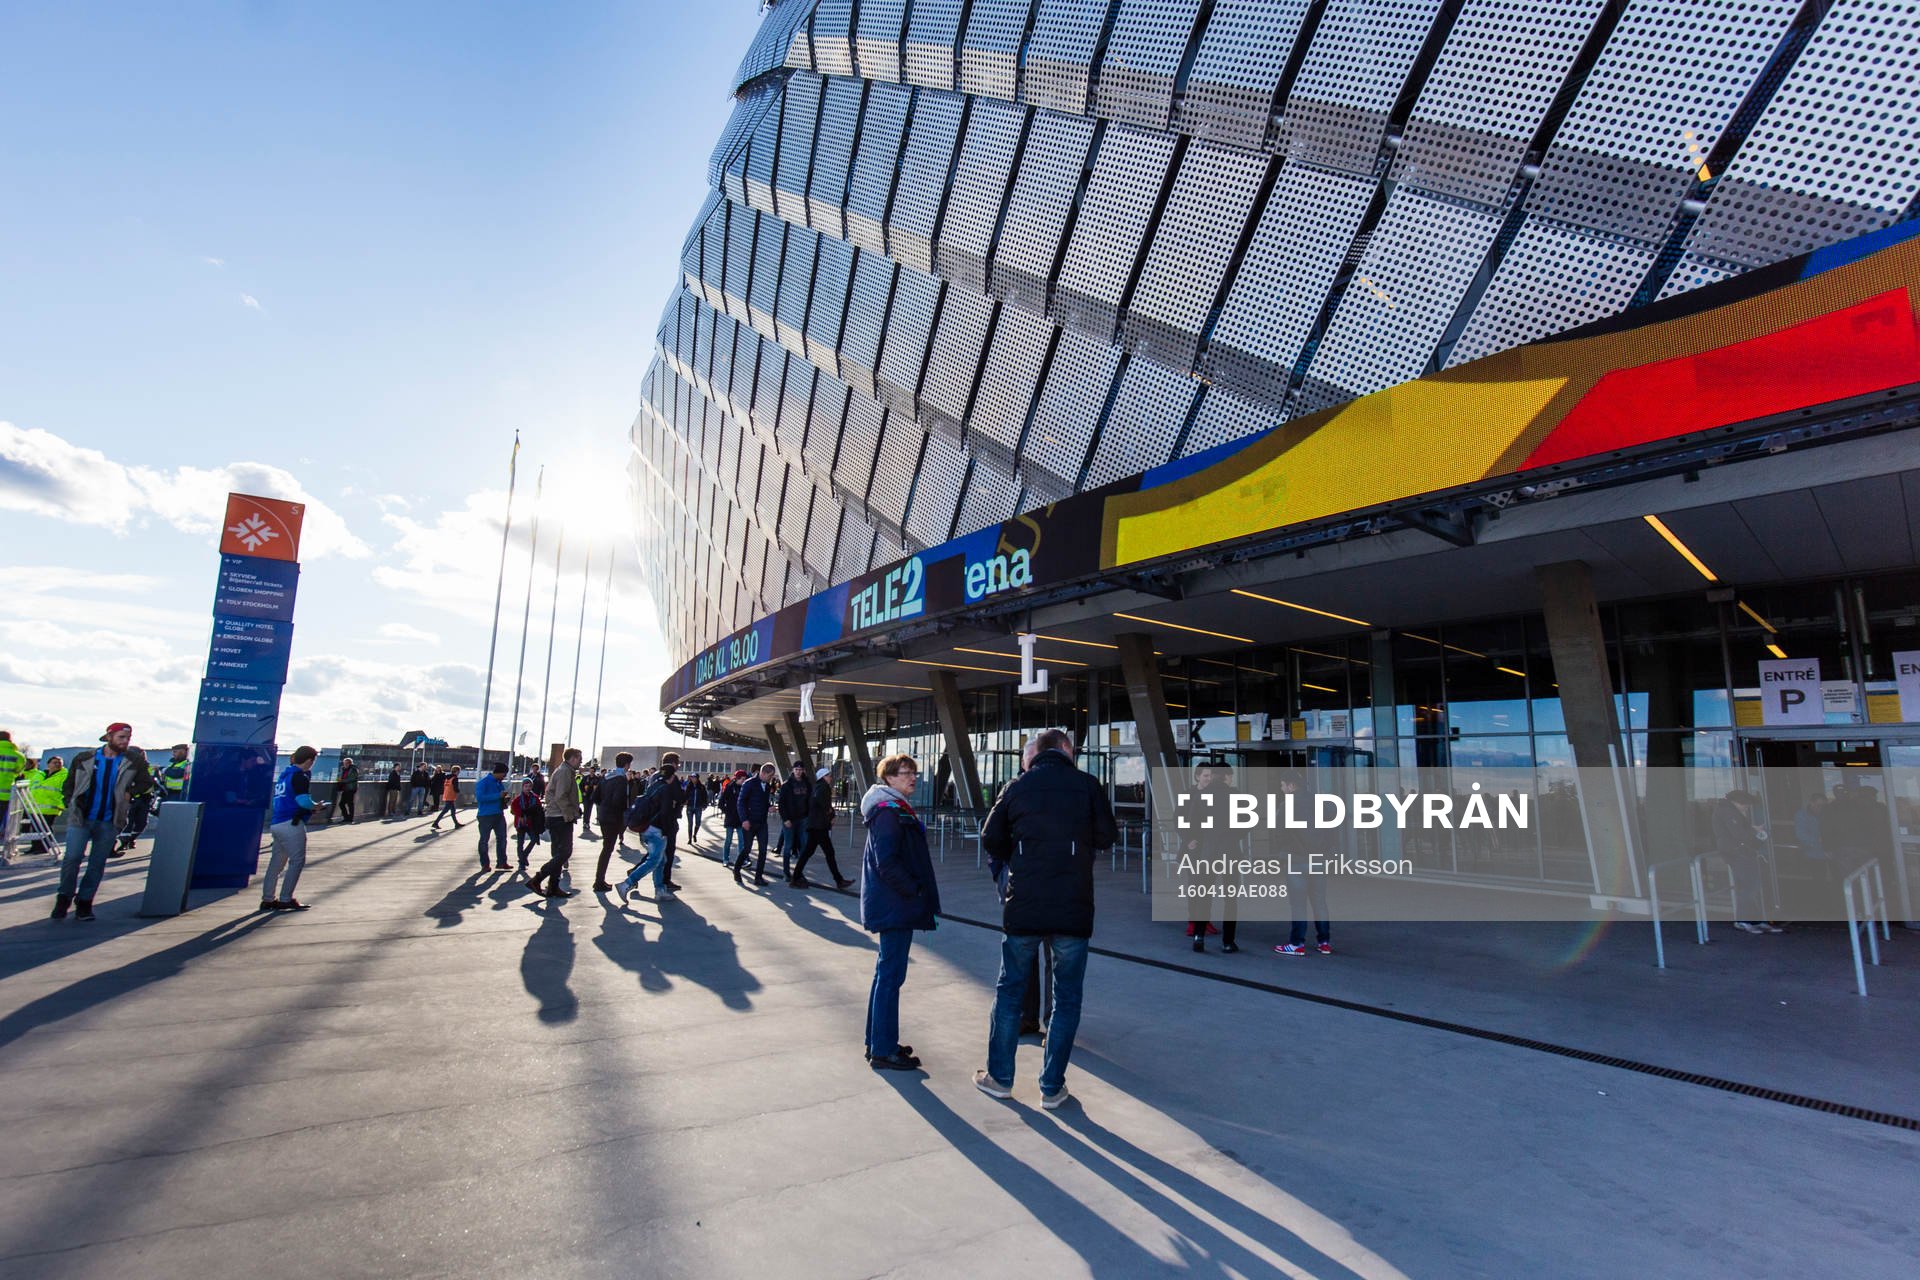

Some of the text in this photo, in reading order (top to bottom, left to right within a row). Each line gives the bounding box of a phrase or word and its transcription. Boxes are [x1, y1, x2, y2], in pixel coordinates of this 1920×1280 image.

[229, 572, 257, 580] SKYVIEW
[254, 589, 284, 597] SHOPPING
[851, 548, 1033, 632] TELE2 ena
[242, 600, 279, 609] STOCKHOLM
[223, 633, 254, 641] ERICSSON
[699, 652, 714, 684] DAG
[715, 645, 727, 676] KL
[730, 630, 759, 670] 19.00
[218, 661, 248, 669] ANNEXET
[1018, 633, 1049, 695] L
[1764, 667, 1816, 682] ENTRÉ
[237, 683, 258, 691] Globen
[1780, 689, 1806, 714] P
